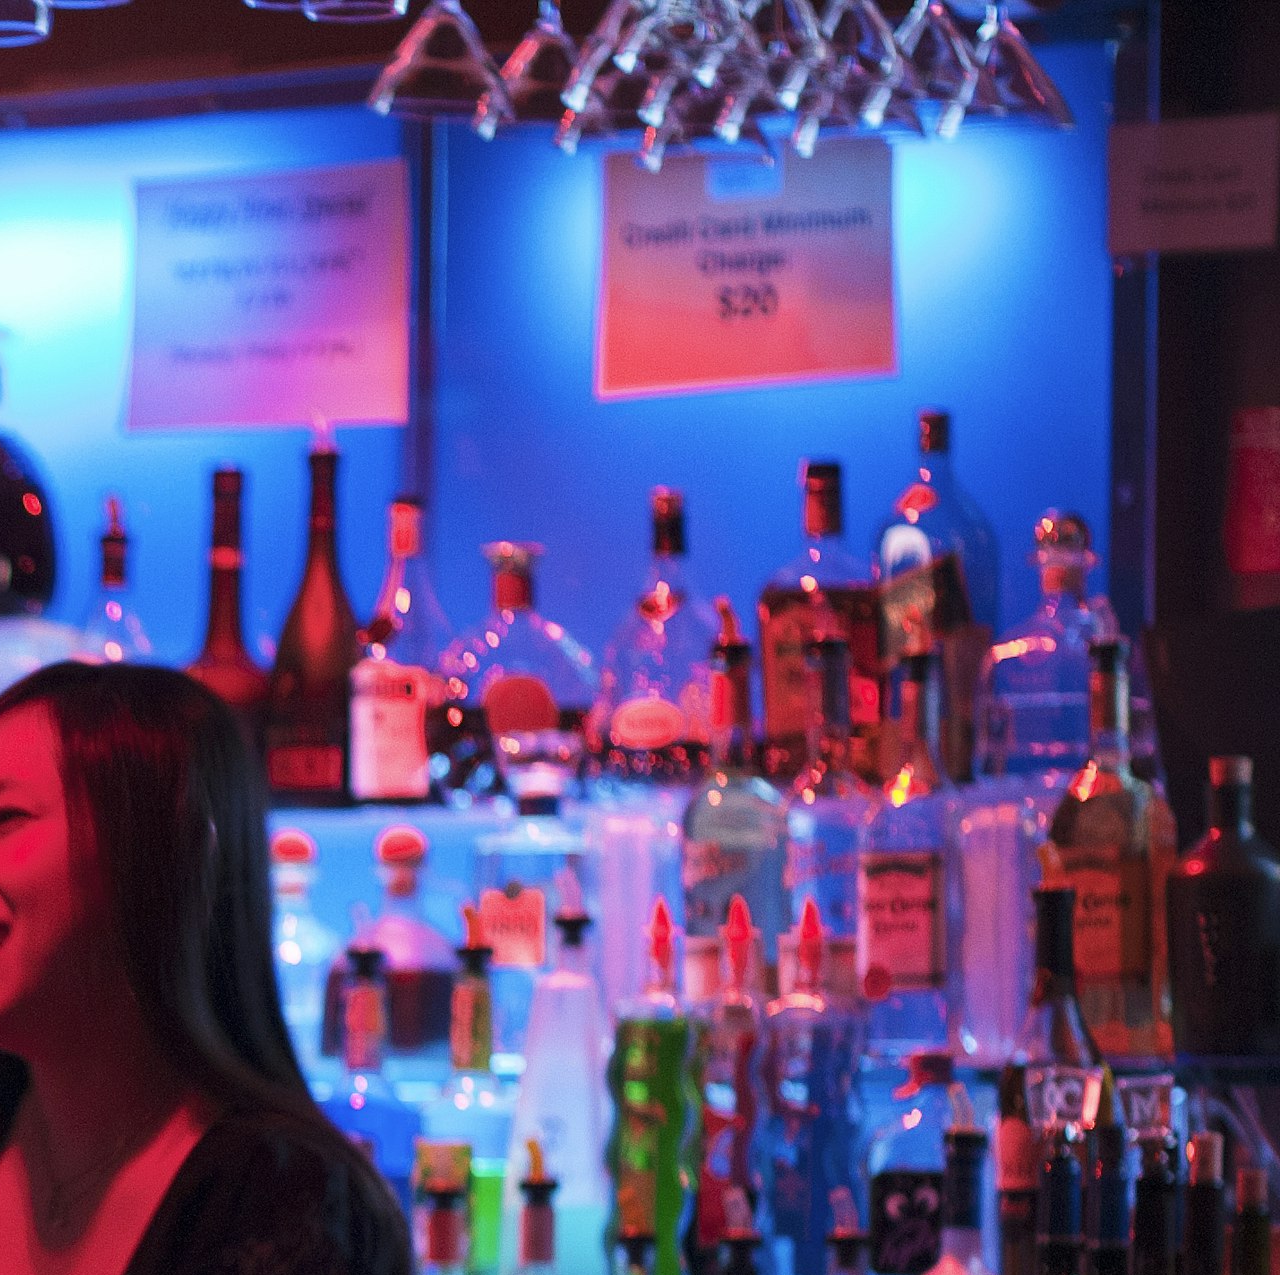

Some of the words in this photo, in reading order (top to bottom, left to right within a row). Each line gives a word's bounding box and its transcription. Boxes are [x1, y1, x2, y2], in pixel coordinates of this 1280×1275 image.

[624, 217, 692, 248] Credit
[698, 213, 756, 239] Card
[761, 206, 873, 236] Minimum
[697, 249, 788, 277] Charge
[716, 283, 780, 321] $20
